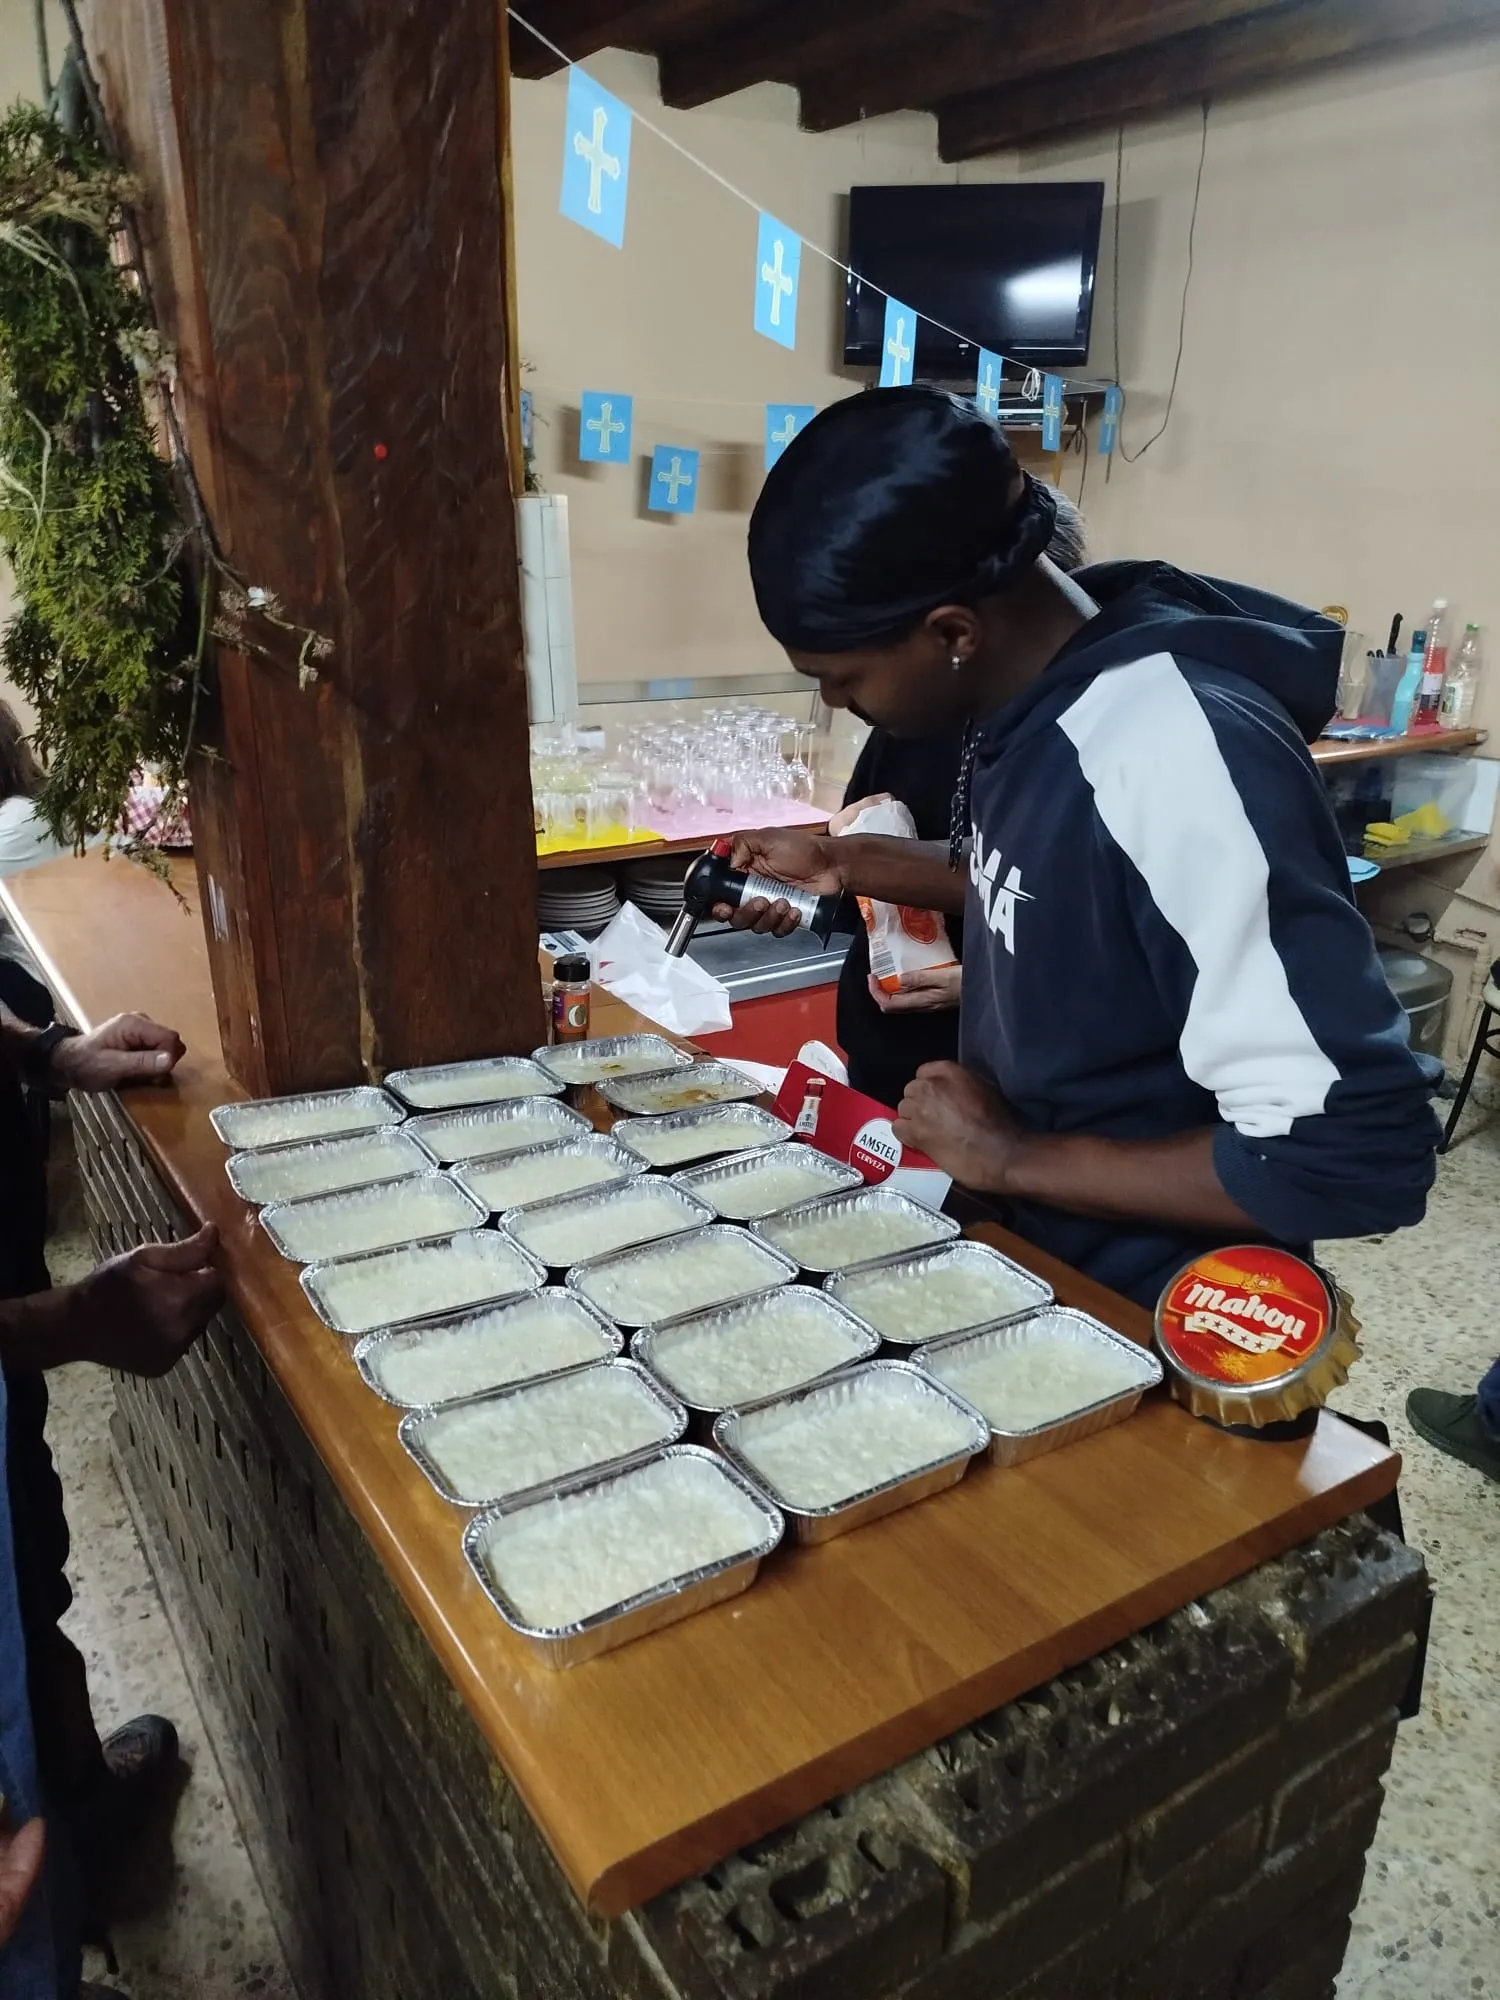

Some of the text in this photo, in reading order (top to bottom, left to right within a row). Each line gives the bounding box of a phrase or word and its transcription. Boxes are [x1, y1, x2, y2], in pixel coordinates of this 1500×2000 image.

[856, 1151, 886, 1173] CERVEZA
[858, 1133, 898, 1162] AMSTEL
[1184, 1283, 1306, 1340] Mahou
